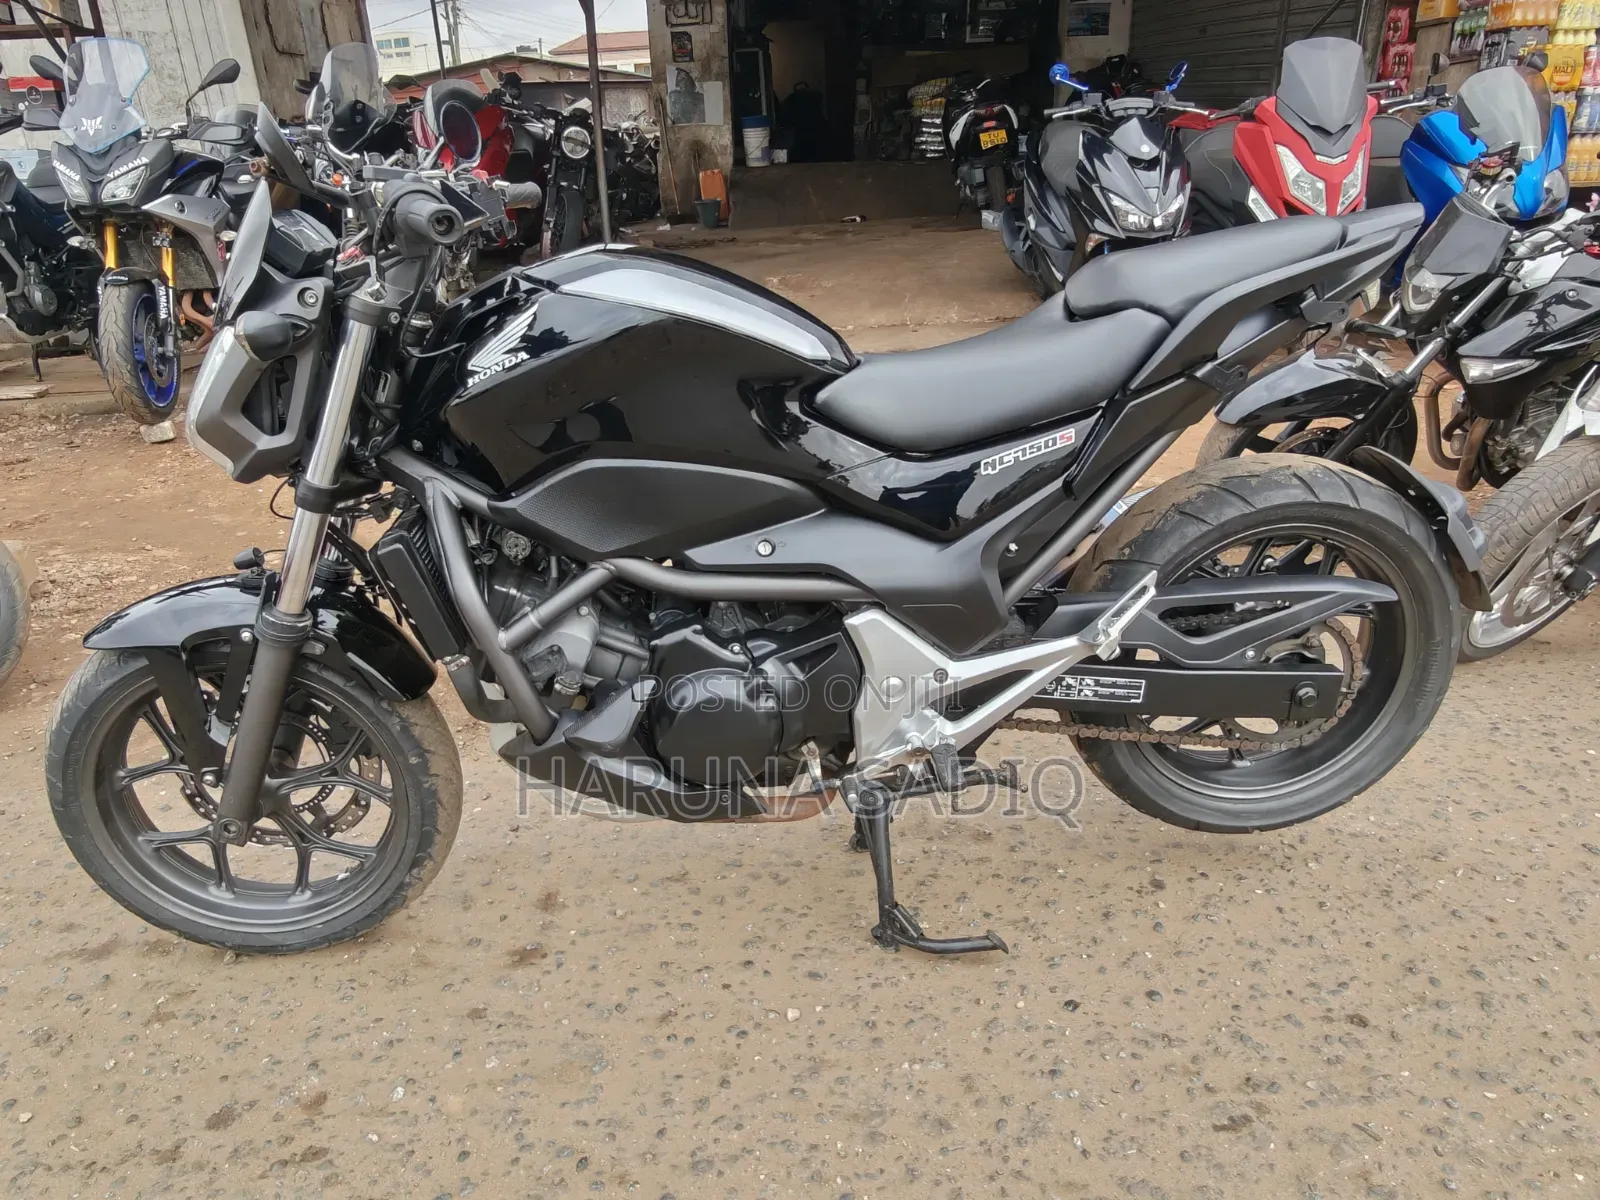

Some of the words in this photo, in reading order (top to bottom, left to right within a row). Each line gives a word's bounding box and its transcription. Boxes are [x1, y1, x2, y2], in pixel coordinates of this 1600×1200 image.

[1553, 65, 1574, 74] MALT
[52, 159, 80, 181] YAMAHA
[106, 156, 150, 178] YAMAHA
[157, 285, 169, 319] YAMAHA
[467, 351, 531, 388] HONDA
[981, 428, 1075, 475] NC750S
